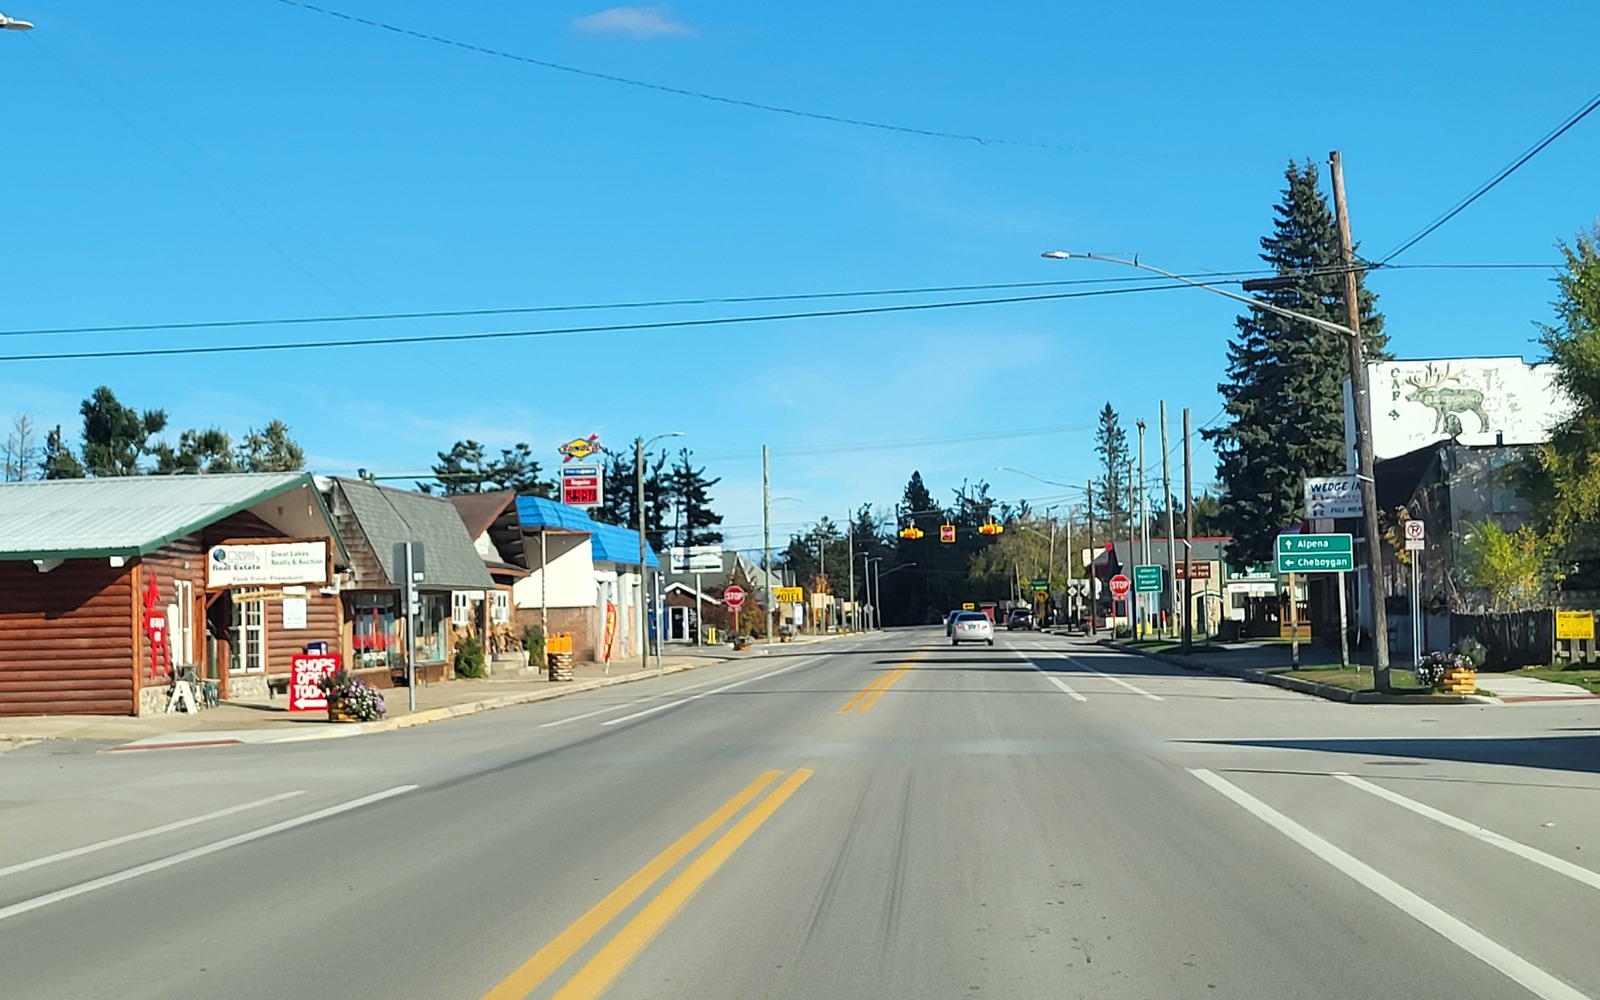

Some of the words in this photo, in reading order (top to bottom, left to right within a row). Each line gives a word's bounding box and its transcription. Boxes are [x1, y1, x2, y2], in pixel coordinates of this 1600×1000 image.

[561, 443, 600, 453] SUNOCO
[1311, 481, 1348, 492] WEDGE
[1348, 505, 1363, 513] MEN
[1297, 539, 1329, 549] Alpena
[234, 563, 261, 571] Estate
[1297, 557, 1348, 570] Cheboygan
[1111, 581, 1127, 590] STOP
[725, 592, 744, 600] STOP
[294, 658, 336, 673] SHOPS
[293, 684, 331, 699] TODA
